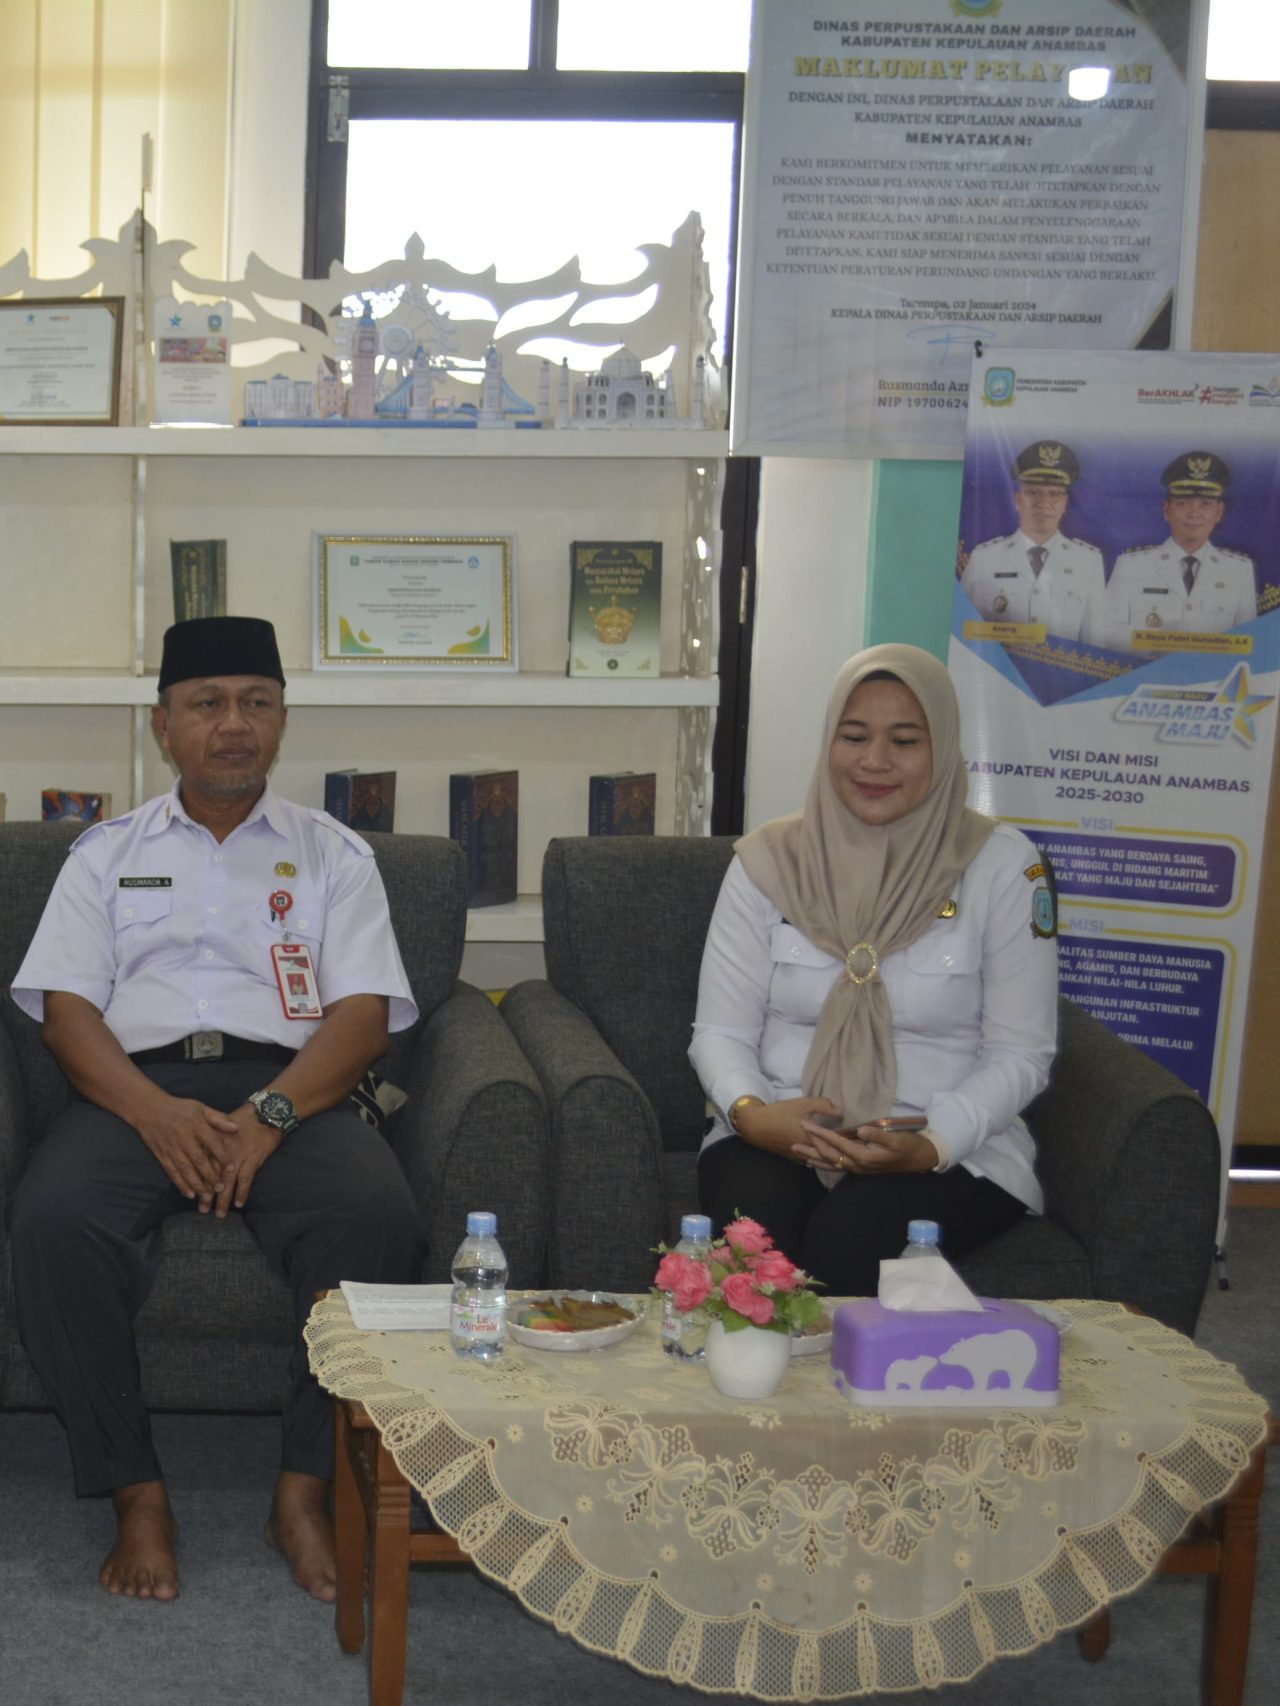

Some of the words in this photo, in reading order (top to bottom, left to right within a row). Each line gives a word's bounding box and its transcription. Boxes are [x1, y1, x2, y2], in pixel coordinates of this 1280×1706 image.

[813, 20, 859, 32] DINAS
[864, 21, 985, 34] PERPUSTAKAAN
[990, 24, 1021, 35] DAN
[1026, 25, 1069, 36] ARSIP
[1074, 26, 1136, 38] DAERAH
[841, 36, 931, 48] KABUPATEN
[936, 38, 1027, 50] KEPULAUAN
[1033, 40, 1106, 51] ANAMBAS
[794, 56, 968, 80] MAKLUMAT
[975, 60, 1153, 84] PELAYAN
[788, 92, 843, 104] DENGAN
[874, 93, 915, 105] DINAS
[919, 95, 1022, 107] PERPUSTAKAAN
[1026, 97, 1053, 108] DAN
[1099, 99, 1154, 110] DAERAH
[854, 112, 931, 124] KABUPATEN
[935, 114, 1015, 126] KEPULAUAN
[1019, 116, 1082, 127] ANAMBAS
[905, 132, 1032, 146] MENYATAKAN:
[781, 158, 812, 169] KAMI
[816, 159, 906, 171] BERKOMITMEN
[910, 161, 952, 171] UNTUK
[1041, 164, 1108, 175] PELAYANAN
[1112, 166, 1153, 176] SESUAI
[772, 176, 821, 186] DENGAN
[825, 177, 880, 187] STANDAR
[884, 178, 952, 189] PELAYANAN
[956, 179, 987, 189] YANG
[991, 180, 1029, 190] TELAH
[1110, 182, 1160, 192] DENGAN
[783, 193, 824, 204] PENUH
[828, 194, 895, 206] TANGGUNG
[898, 196, 935, 206] JAWAB
[938, 196, 962, 207] DAN
[966, 197, 997, 208] AKAN
[1001, 198, 1076, 209] MELAKUKAN
[1080, 200, 1148, 210] PERBAIKAN
[787, 211, 833, 222] SECARA
[897, 213, 921, 224] DAN
[977, 215, 1018, 226] DALAM
[1022, 216, 1141, 228] PENYELENGGARAAN
[776, 228, 845, 239] PELAYANAN
[848, 230, 880, 240] KAMI
[884, 231, 919, 241] TIDAK
[922, 231, 964, 242] SESUAI
[967, 232, 1016, 243] DENGAN
[1020, 234, 1073, 244] STANDAR
[1077, 235, 1108, 245] YANG
[1112, 235, 1150, 246] TELAH
[866, 248, 897, 258] KAMI
[901, 249, 927, 259] SIAP
[930, 249, 996, 260] MENERIMA
[999, 251, 1041, 261] SANKSI
[1045, 252, 1086, 262] SESUAI
[1089, 252, 1139, 263] DENGAN
[766, 263, 837, 275] KETENTUAN
[841, 265, 912, 276] PERATURAN
[1065, 269, 1096, 280] YANG
[1011, 301, 1037, 311] 2024
[831, 309, 871, 319] KEPALA
[875, 310, 908, 320] DINAS
[911, 310, 996, 322] PERPUSTAKAAN
[999, 312, 1020, 322] DAN
[1024, 313, 1056, 323] ARSIP
[1059, 314, 1102, 324] DAERAH
[878, 379, 945, 392] Rusmanda
[1137, 388, 1195, 398] BerAKHLAK
[878, 397, 902, 408] NIP
[907, 397, 969, 409] 19700624
[1123, 701, 1235, 722] ANAMBAS
[1166, 722, 1230, 740] MAJU
[1049, 748, 1080, 762] VISI
[1085, 751, 1120, 765] DAN
[1124, 753, 1159, 768] MISI
[967, 761, 1055, 780] ABUPATEN
[1060, 767, 1162, 787] KEPULAUAN
[1166, 776, 1250, 793] ANAMBAS
[1055, 785, 1144, 804] 2025-2030
[1081, 816, 1113, 831] VISI
[1047, 843, 1096, 857] ANAMBAS
[1098, 847, 1125, 860] YANG
[1127, 850, 1170, 864] BERDAYA
[1173, 854, 1207, 868] SAING,
[1071, 858, 1110, 872] UNGGUL
[1112, 862, 1123, 873] DI
[1124, 863, 1161, 876] BIDANG
[1164, 867, 1208, 880] MARITIM
[1076, 872, 1102, 884] YANG
[1104, 875, 1132, 888] MAJU
[1135, 878, 1156, 889] DAN
[1069, 918, 1104, 933] MISI
[1096, 948, 1136, 962] SUMBER
[1138, 952, 1164, 965] DAYA
[1166, 956, 1212, 970] MANUSIA
[1075, 961, 1118, 975] AGAMIS,
[1120, 965, 1140, 977] DAN
[1142, 968, 1199, 982] BERBUDAYA
[1149, 982, 1184, 994] LUHUR.
[1120, 999, 1200, 1017] INFRASTRUKTUR
[1087, 1010, 1140, 1024] ANJUTAN.
[1151, 1036, 1193, 1050] MELALUI
[459, 1319, 498, 1332] Minerale
